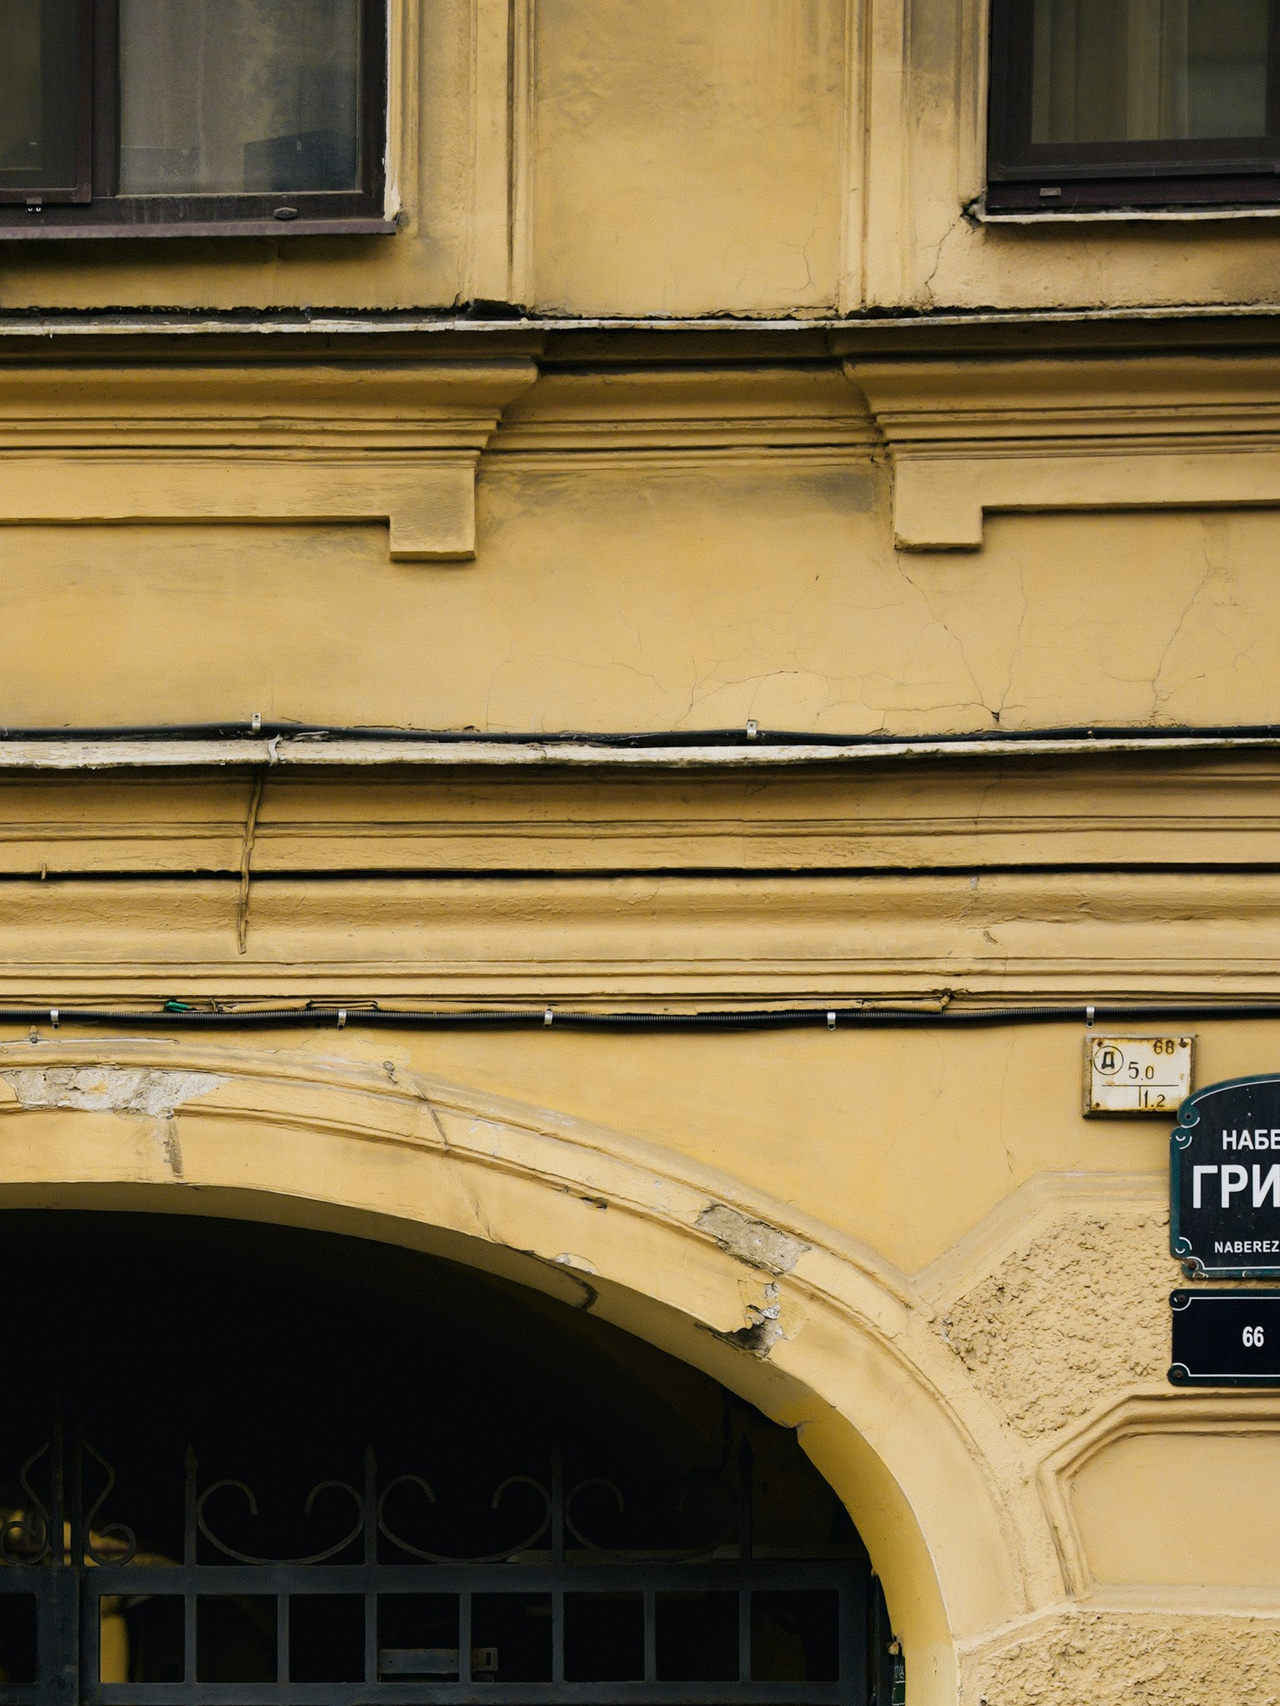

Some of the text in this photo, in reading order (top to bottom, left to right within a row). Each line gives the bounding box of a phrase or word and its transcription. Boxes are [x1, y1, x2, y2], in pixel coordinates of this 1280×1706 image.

[1153, 1039, 1175, 1055] 68
[1101, 1051, 1115, 1070] Д
[1128, 1061, 1155, 1081] 5.0
[1144, 1089, 1166, 1109] 1.2
[1193, 1164, 1280, 1209] ГРИ
[1214, 1241, 1280, 1254] NABEREZ
[1242, 1326, 1265, 1347] 66
